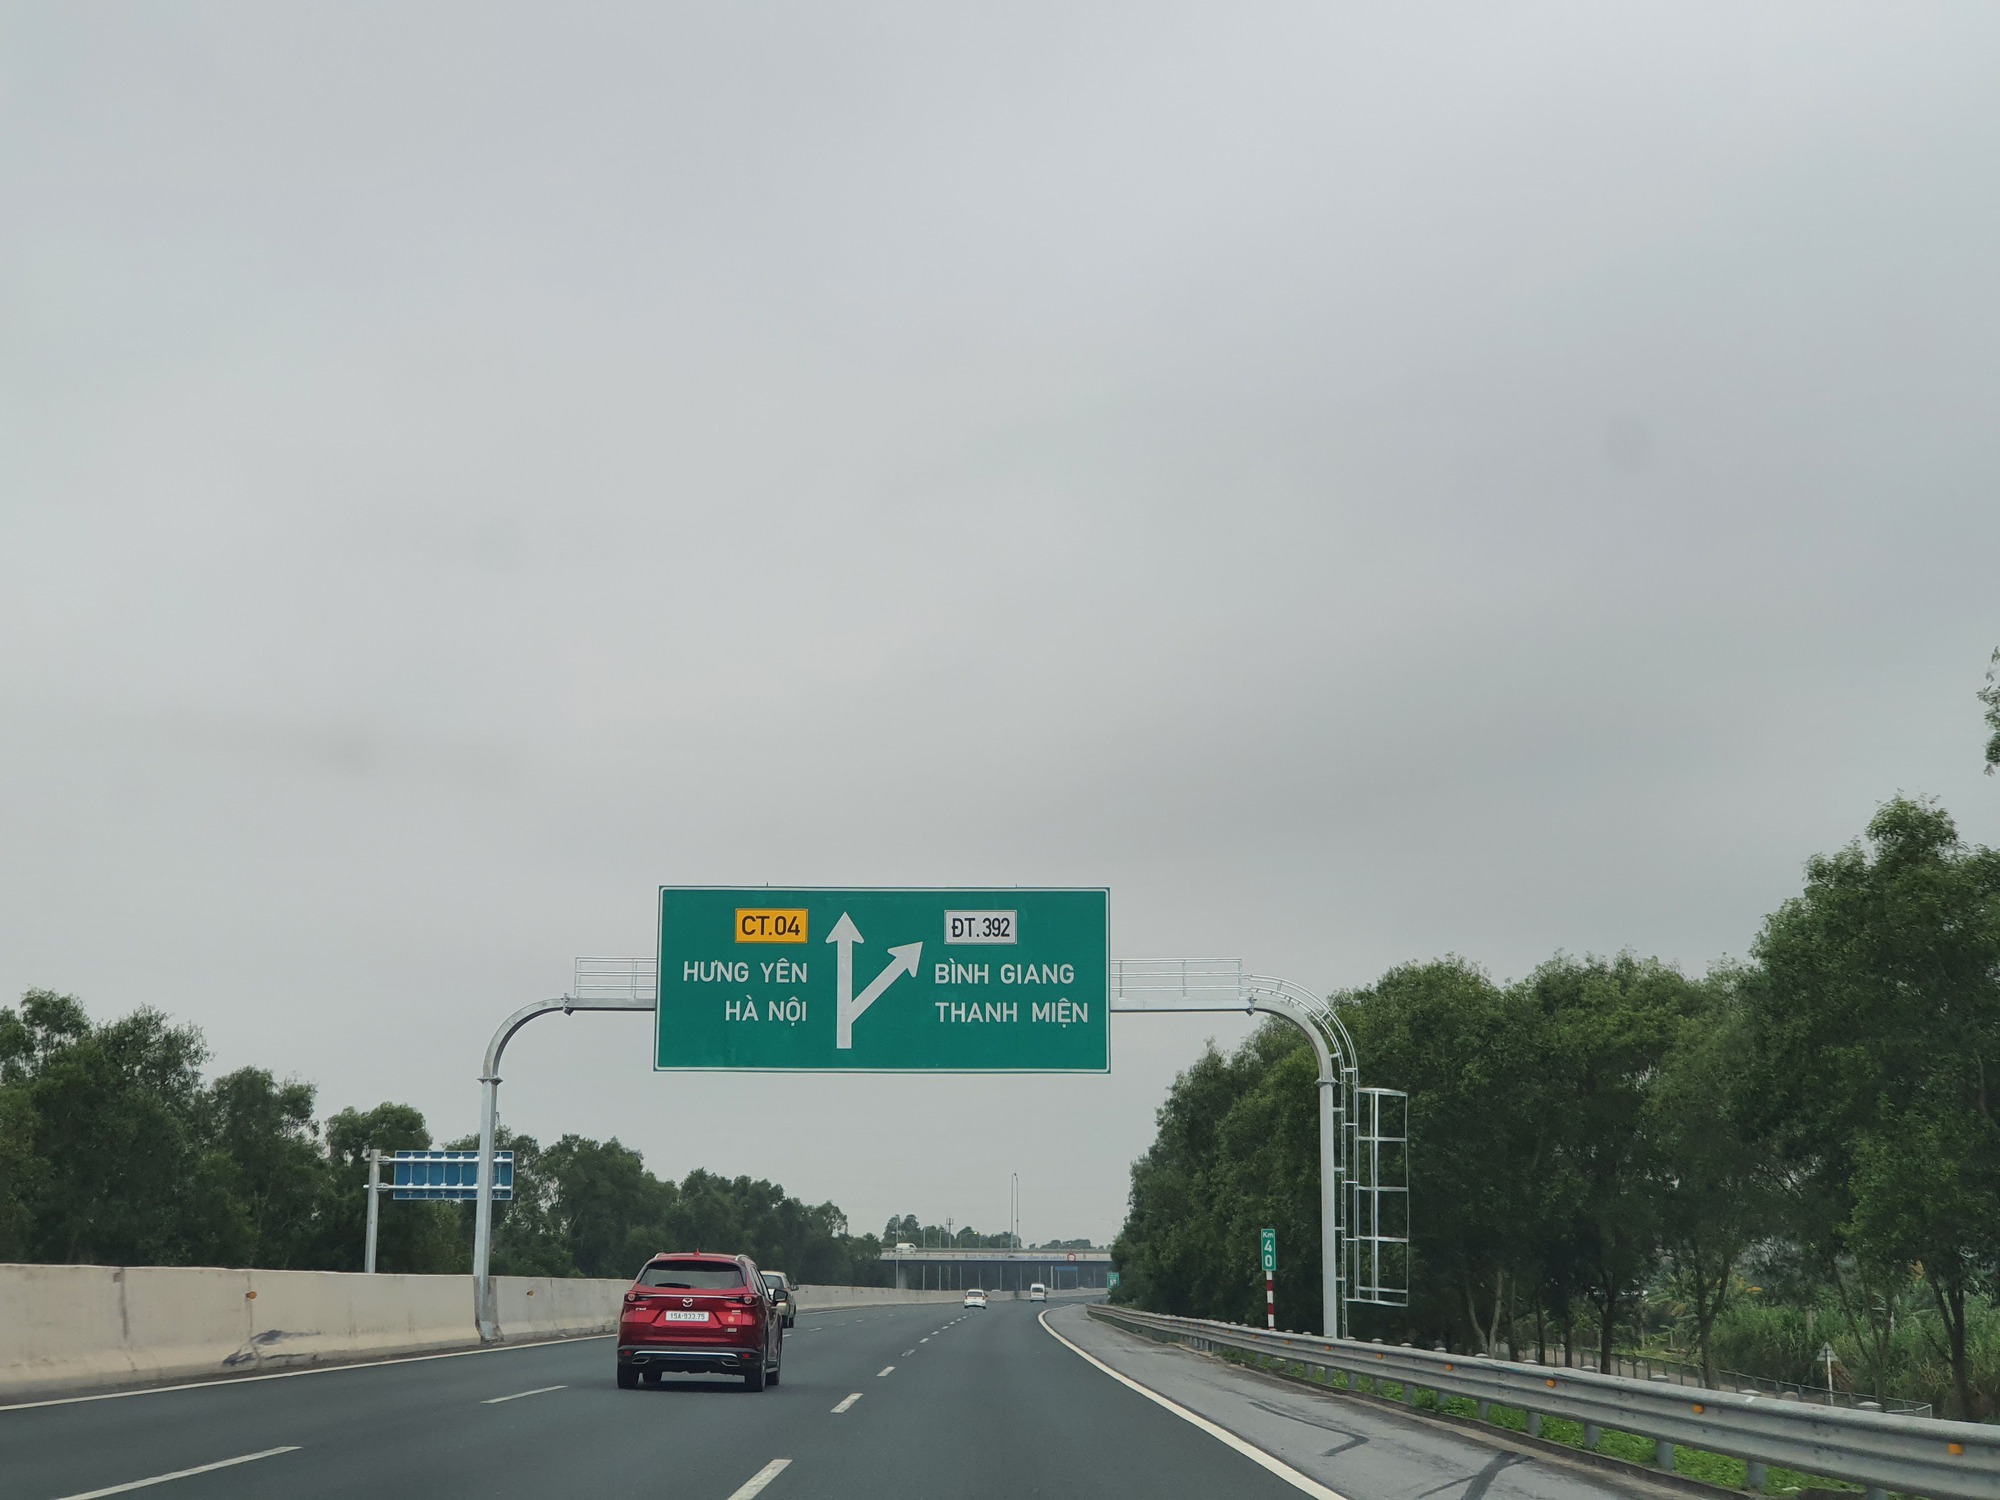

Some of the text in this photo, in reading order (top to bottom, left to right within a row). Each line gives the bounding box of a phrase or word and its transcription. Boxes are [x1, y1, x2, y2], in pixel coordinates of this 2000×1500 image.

[741, 915, 801, 936] CT.04
[951, 917, 1011, 938] ĐT.392
[683, 957, 808, 984] HƯNG YÊN
[934, 957, 1075, 985] BÌNH GIANG
[725, 994, 807, 1027] HÀ NỘI
[934, 997, 1089, 1029] THANH MIỆN
